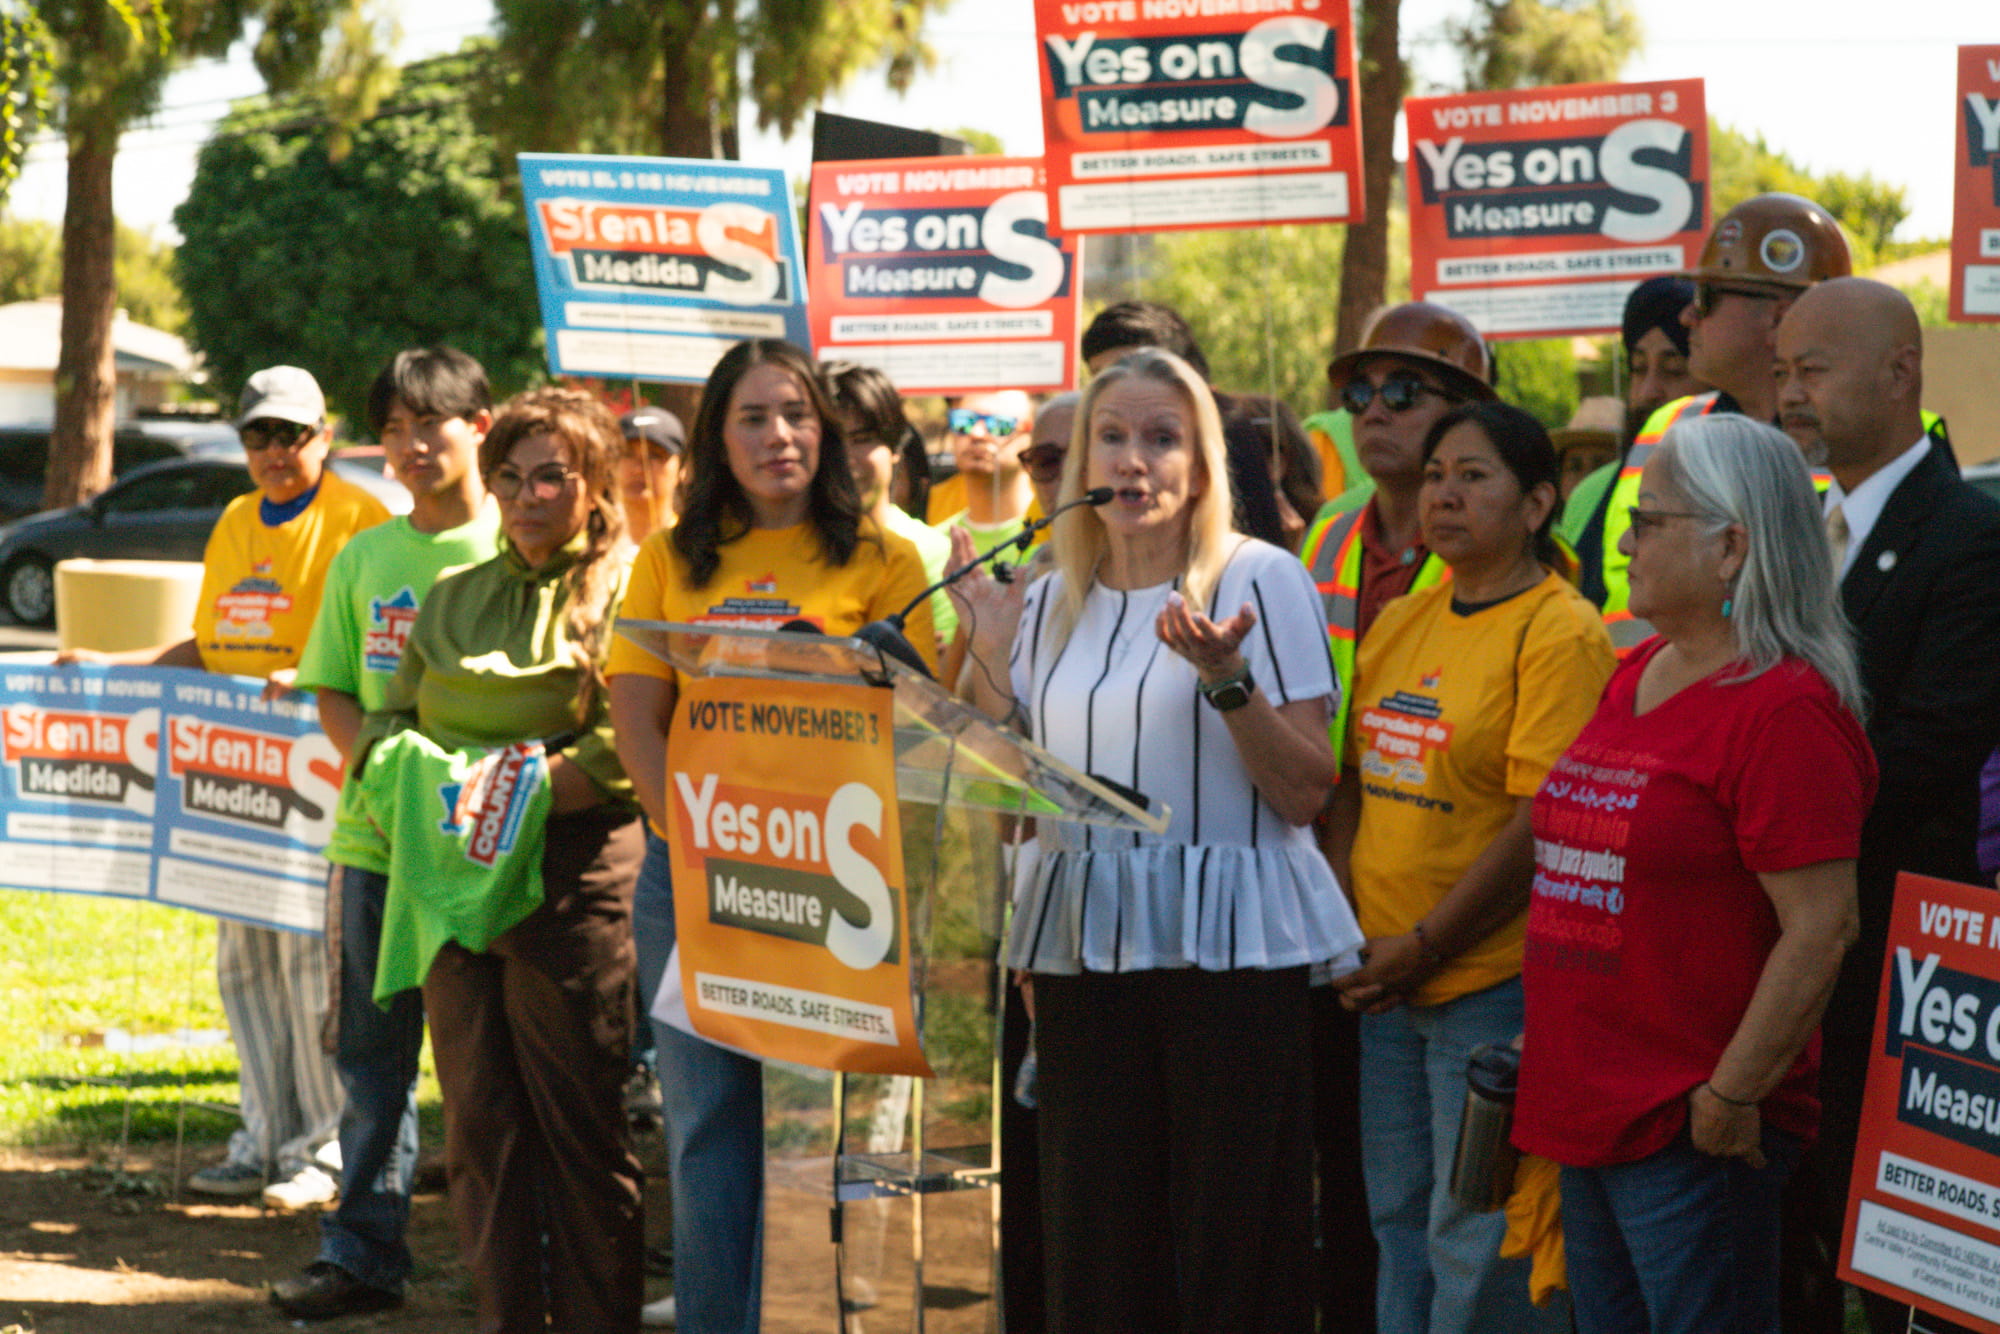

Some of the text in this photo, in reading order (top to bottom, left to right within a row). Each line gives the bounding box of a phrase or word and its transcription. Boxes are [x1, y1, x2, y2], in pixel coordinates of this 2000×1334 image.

[1062, 1, 1136, 25] VOTE
[1144, 0, 1294, 20] NOVEMBER
[1046, 16, 1339, 138] Yes on S
[1088, 97, 1237, 127] Measure
[1433, 90, 1679, 130] VOTE NOVEMBER 3
[836, 170, 899, 196] VOTE
[904, 166, 1034, 193] NOVEMBER
[1416, 119, 1692, 242] Yes on S
[1454, 201, 1595, 232] Measure
[583, 253, 699, 286] Medida
[600, 211, 652, 244] en
[654, 211, 691, 246] la
[697, 202, 780, 306] S
[819, 201, 908, 254] Yes
[914, 213, 978, 250] on
[978, 190, 1065, 309] S
[848, 264, 977, 293] Measure
[5, 674, 46, 693] VOTE
[106, 679, 162, 699] NOVIEM
[175, 684, 212, 706] VOTE
[6, 703, 45, 756] Sí
[46, 720, 88, 752] en
[93, 715, 120, 754] la
[689, 701, 880, 745] VOTE NOVEMBER 3
[29, 762, 120, 796] Medida
[174, 715, 343, 847] Sí en la S
[192, 777, 281, 821] Medida
[474, 743, 524, 856] COUNTY
[674, 772, 894, 970] Yes on S
[715, 873, 822, 927] Measure
[1920, 901, 1985, 945] VOTE
[702, 981, 891, 1036] BETTER ROADS. SAFE STREETS.
[1896, 946, 1980, 1051] Yes
[1906, 1067, 2000, 1137] Measu
[1884, 1163, 1936, 1197] BETTER
[1937, 1181, 1989, 1215] ROADS.
